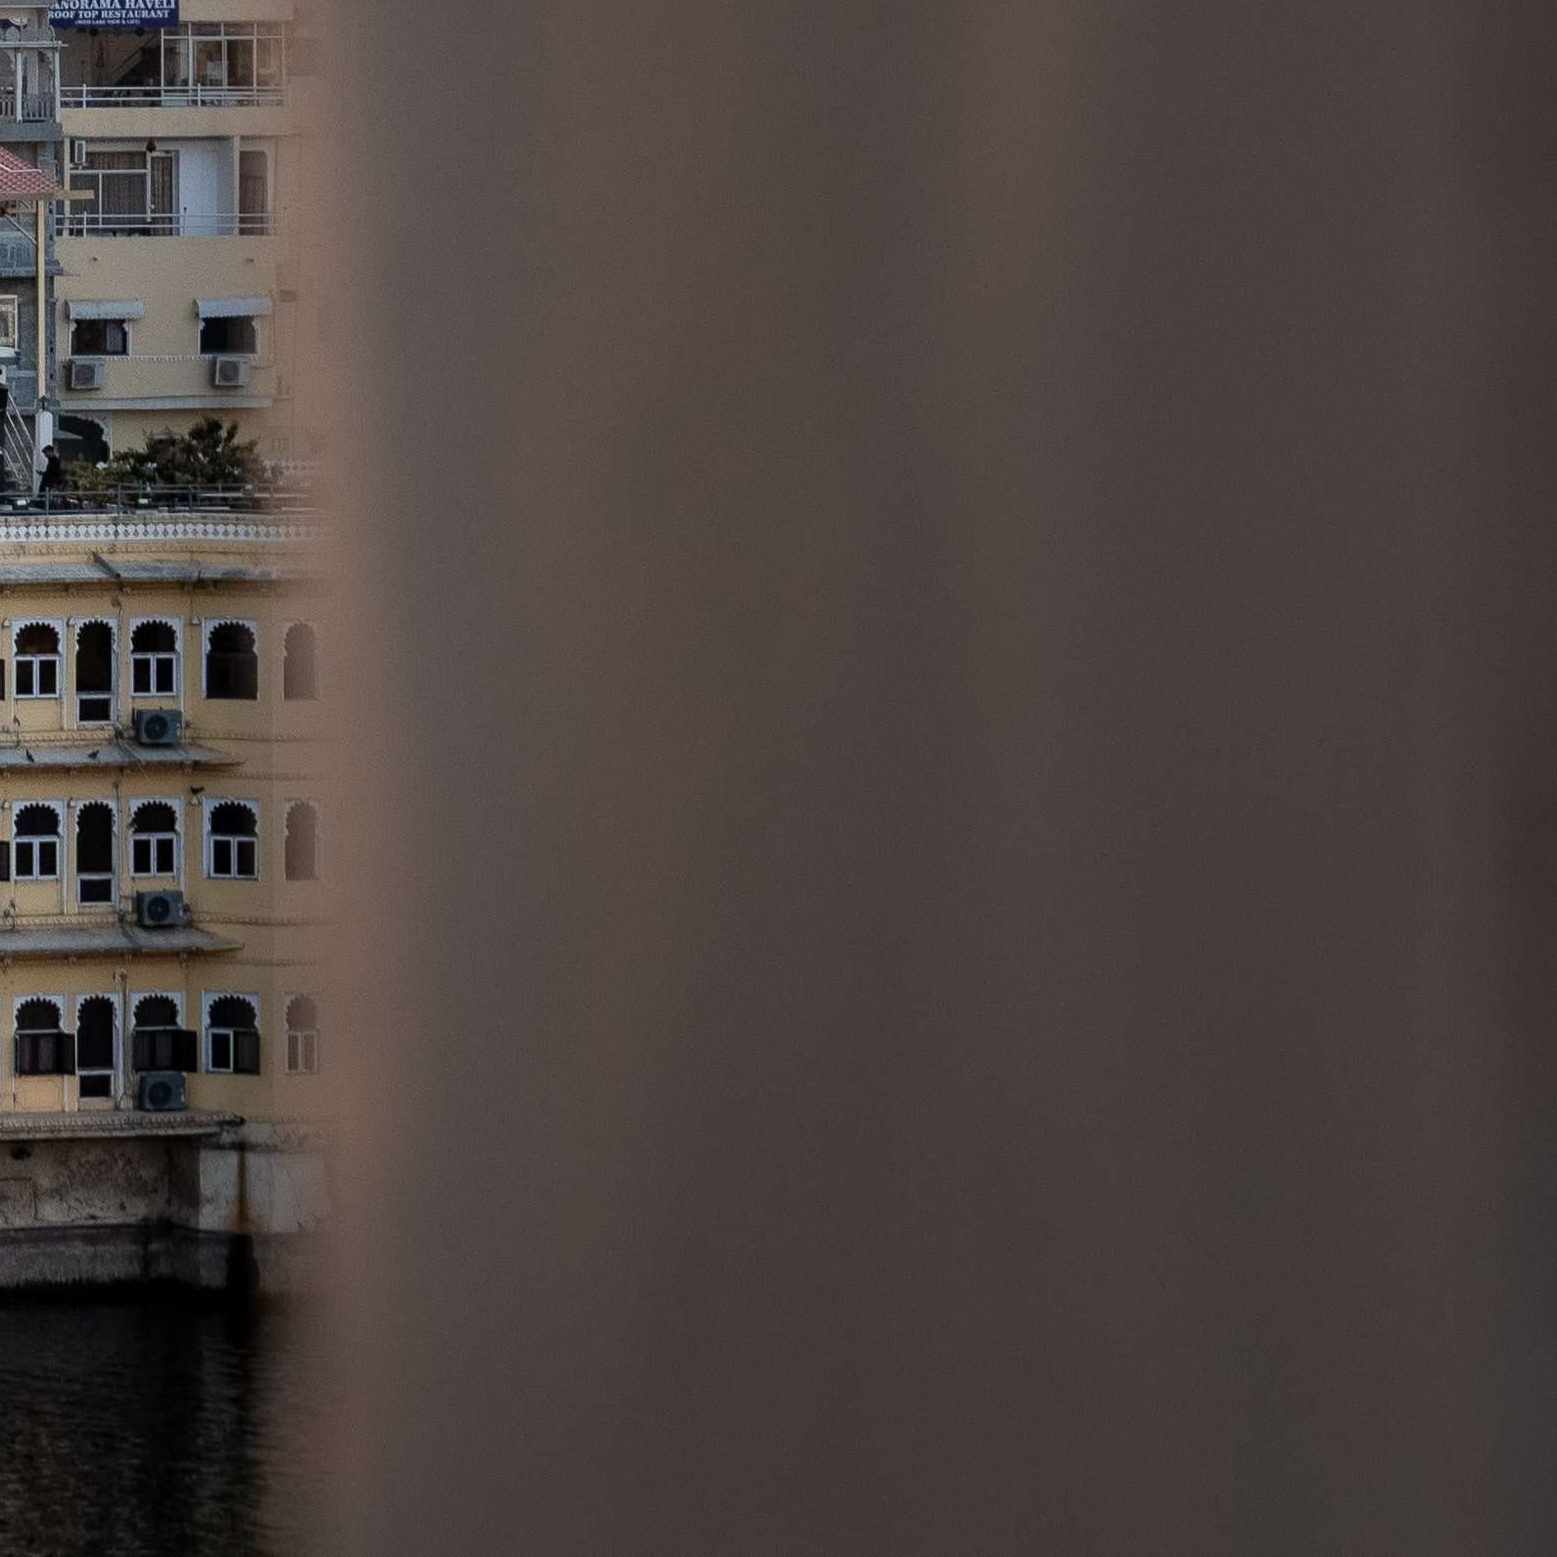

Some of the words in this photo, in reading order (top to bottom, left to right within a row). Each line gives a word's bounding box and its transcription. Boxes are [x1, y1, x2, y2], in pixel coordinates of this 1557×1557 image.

[48, 10, 76, 19] ROOF
[78, 10, 99, 19] TOP
[101, 9, 170, 19] RESTAURANT
